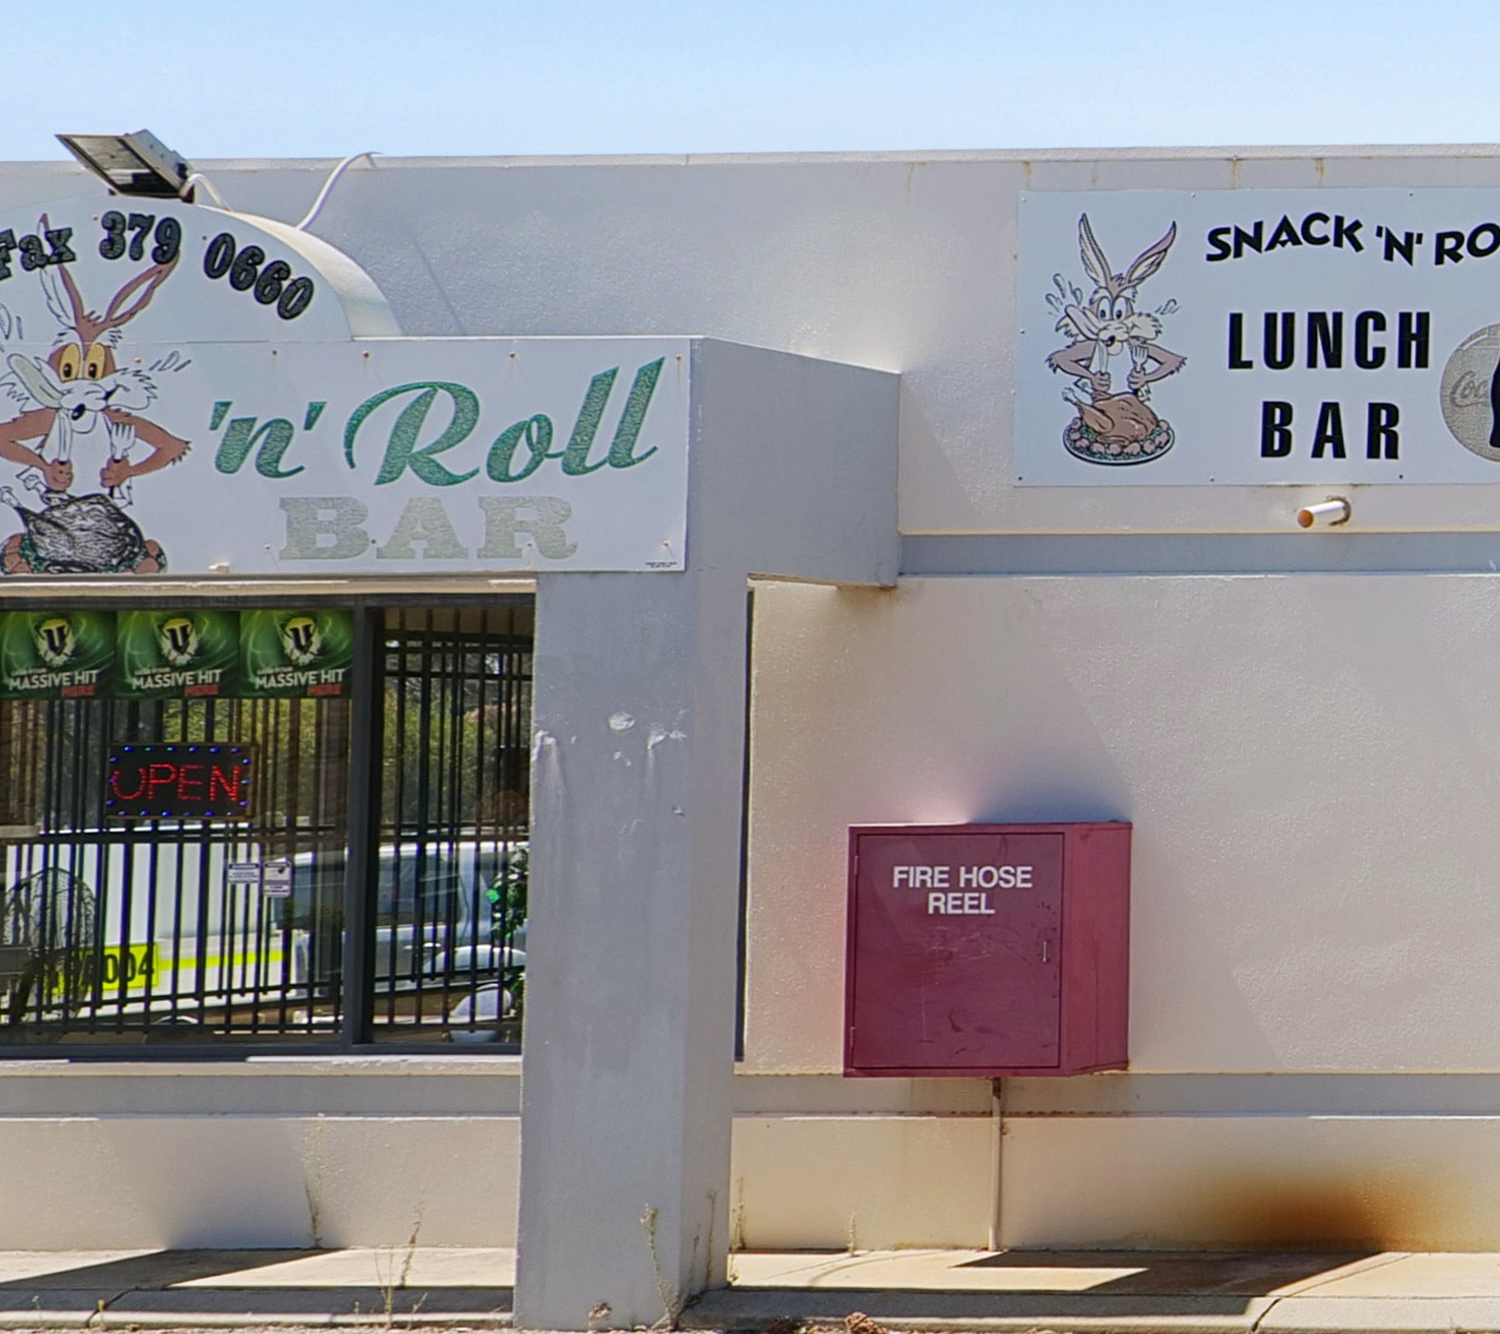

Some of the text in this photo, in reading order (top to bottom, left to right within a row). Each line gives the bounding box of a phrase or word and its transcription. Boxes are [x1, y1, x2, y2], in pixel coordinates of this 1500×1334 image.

[99, 210, 182, 264] 379
[203, 232, 315, 320] 0660
[1205, 212, 1364, 262] SNACK
[1375, 225, 1424, 267] 'N'
[1227, 310, 1430, 370] LUNCH
[343, 356, 665, 486] Roll
[1260, 400, 1400, 460] BAR
[278, 495, 578, 561] BAR
[9, 669, 99, 691] MASSIVE HIT
[132, 669, 222, 690] MASSIVE HIT
[255, 668, 346, 689] MASSIVE HIT
[892, 866, 1033, 888] FIRE HOSE
[927, 892, 996, 914] REEL
